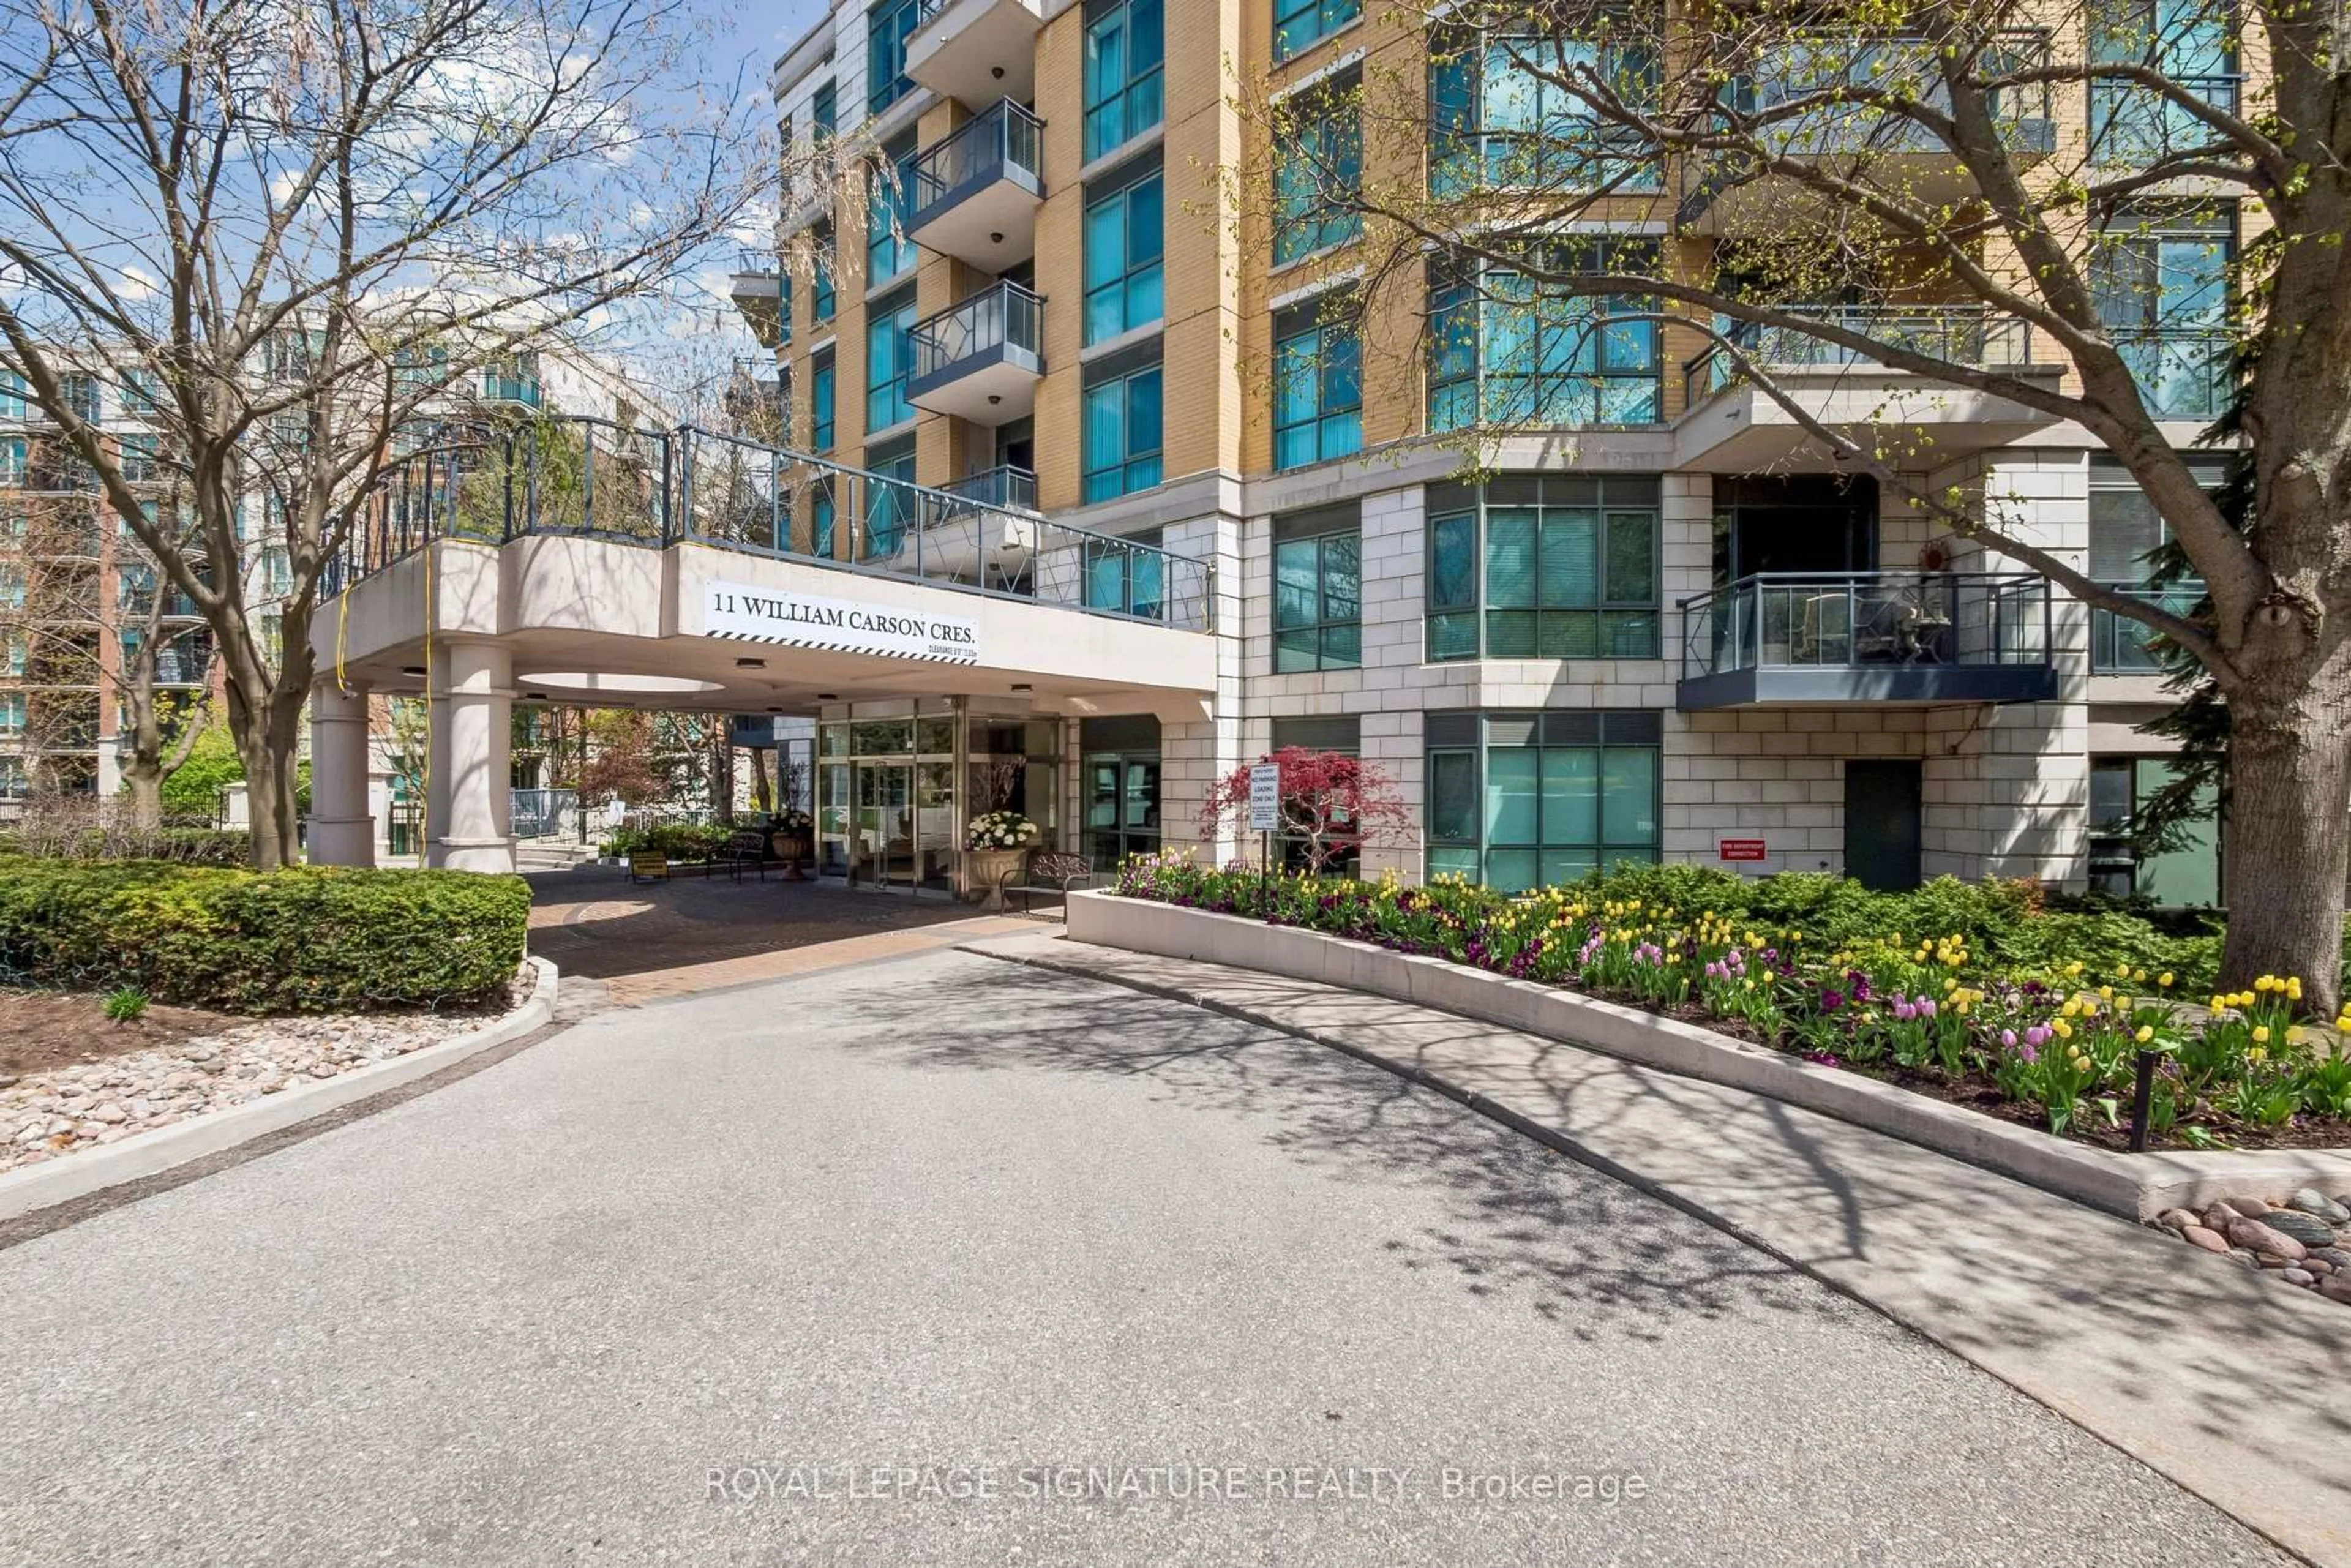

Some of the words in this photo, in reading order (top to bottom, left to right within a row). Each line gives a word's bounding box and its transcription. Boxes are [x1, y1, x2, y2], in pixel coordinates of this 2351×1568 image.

[714, 593, 735, 613] 11
[742, 596, 844, 627] WILLIAM
[849, 611, 926, 637] CARSON
[930, 623, 975, 644] CRES.
